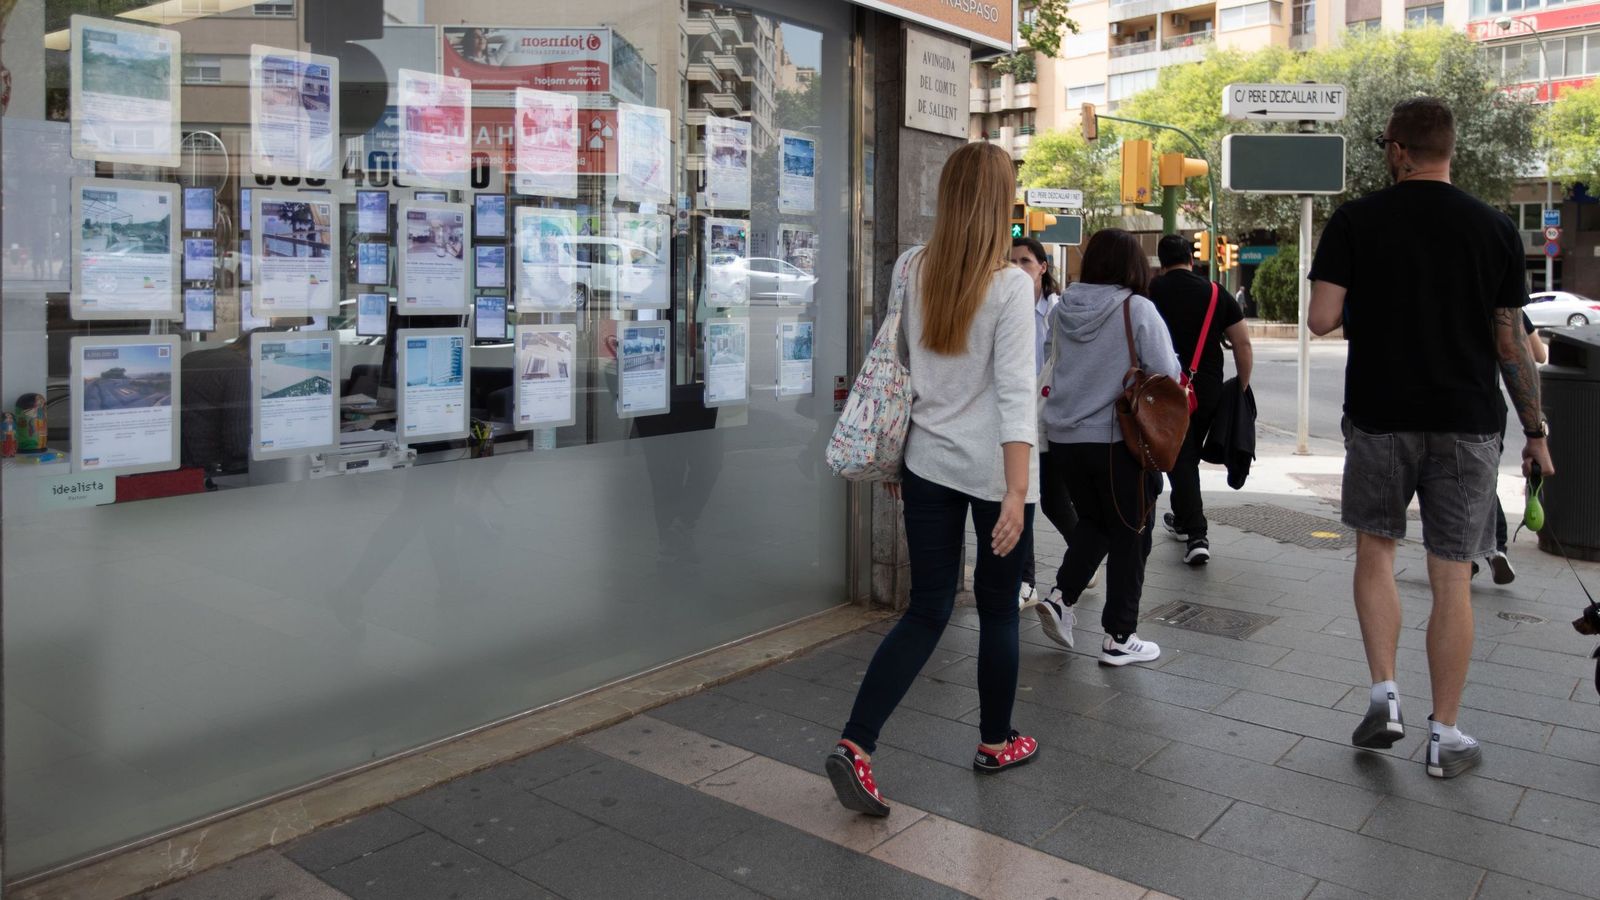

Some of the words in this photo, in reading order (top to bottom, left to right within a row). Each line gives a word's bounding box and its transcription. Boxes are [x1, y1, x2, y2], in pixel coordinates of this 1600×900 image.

[922, 51, 956, 73] AVINGUDA
[920, 74, 932, 91] DEL
[934, 78, 957, 97] COMTE
[1234, 89, 1246, 103] C/
[1248, 90, 1267, 103] PERE
[1269, 90, 1318, 104] DEZCALLAR
[1325, 91, 1342, 104] NET
[918, 99, 927, 114] DE
[929, 101, 958, 121] SALLENT
[52, 481, 104, 496] idealista
